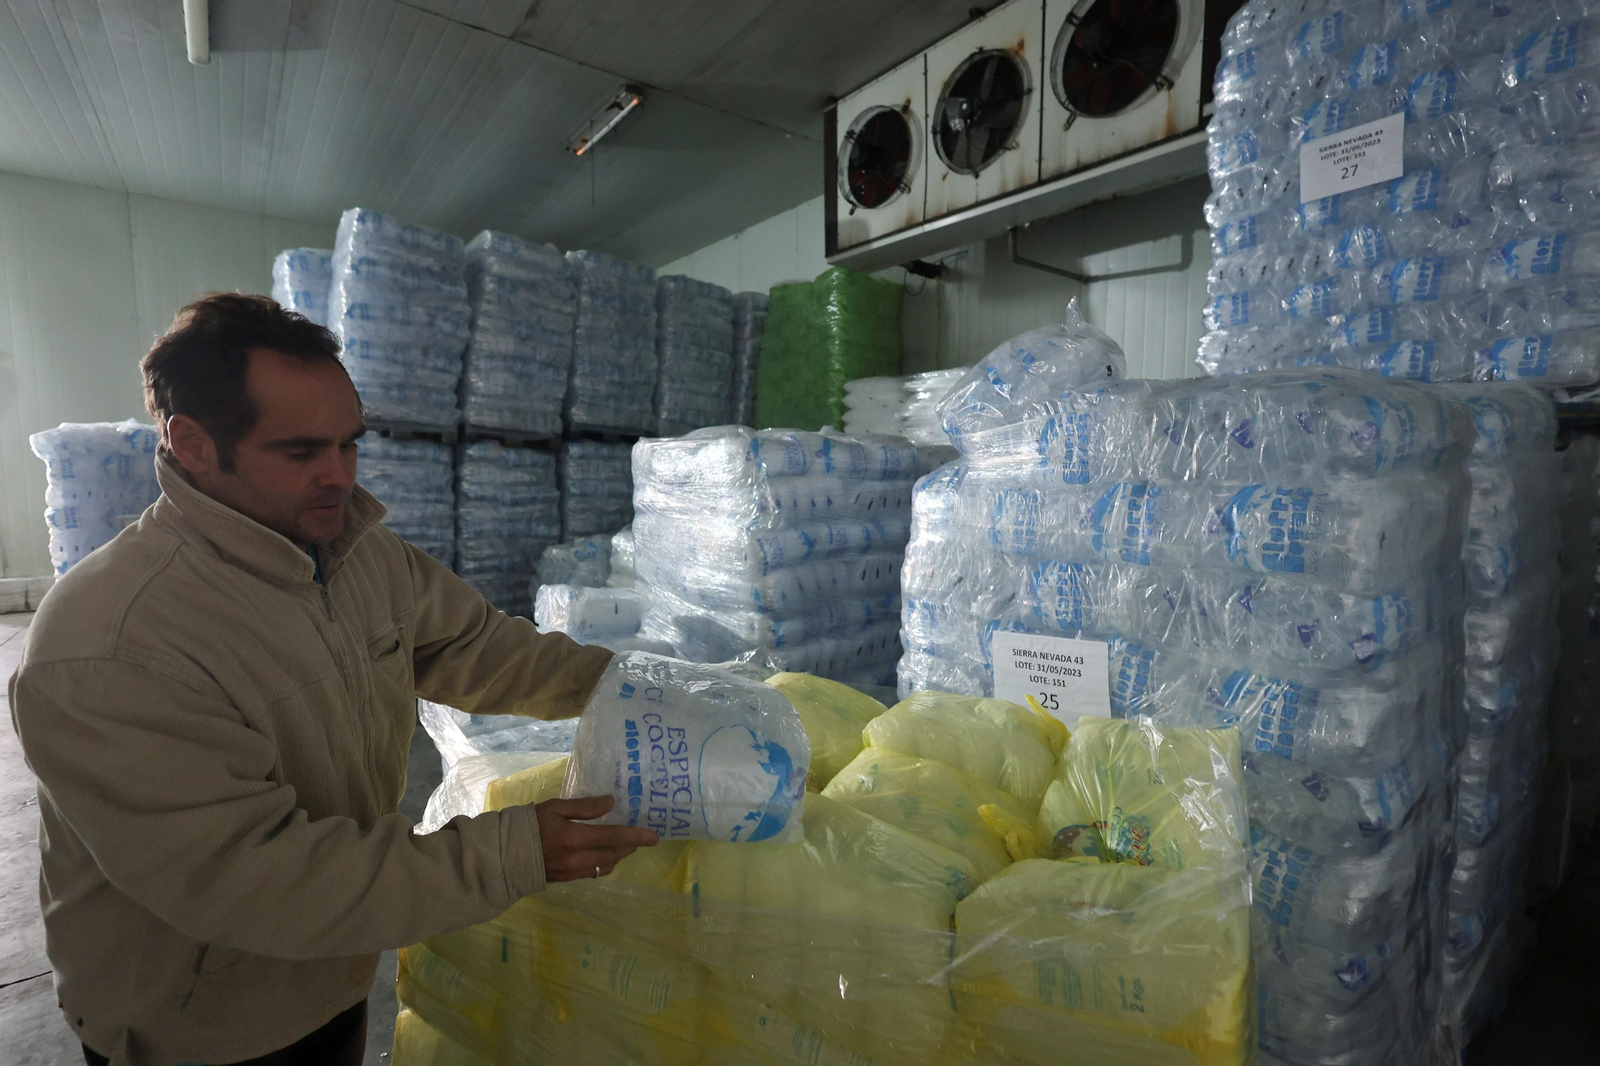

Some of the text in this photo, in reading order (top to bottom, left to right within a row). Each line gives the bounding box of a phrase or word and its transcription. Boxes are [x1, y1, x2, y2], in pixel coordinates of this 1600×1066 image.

[1319, 141, 1342, 153] SIERRA
[1343, 132, 1373, 146] NEVADA
[1320, 138, 1381, 161] LOTE: 31/05/2023
[1333, 151, 1366, 165] LOTE: 151
[1341, 164, 1359, 180] 27
[1012, 648, 1084, 665] SIERRA NEVADA 43
[1014, 660, 1082, 678] LOTE: 31/05/2023
[1029, 674, 1067, 688] LOTE: 151
[1039, 692, 1060, 711] 25
[667, 725, 693, 839] ESPECIAL
